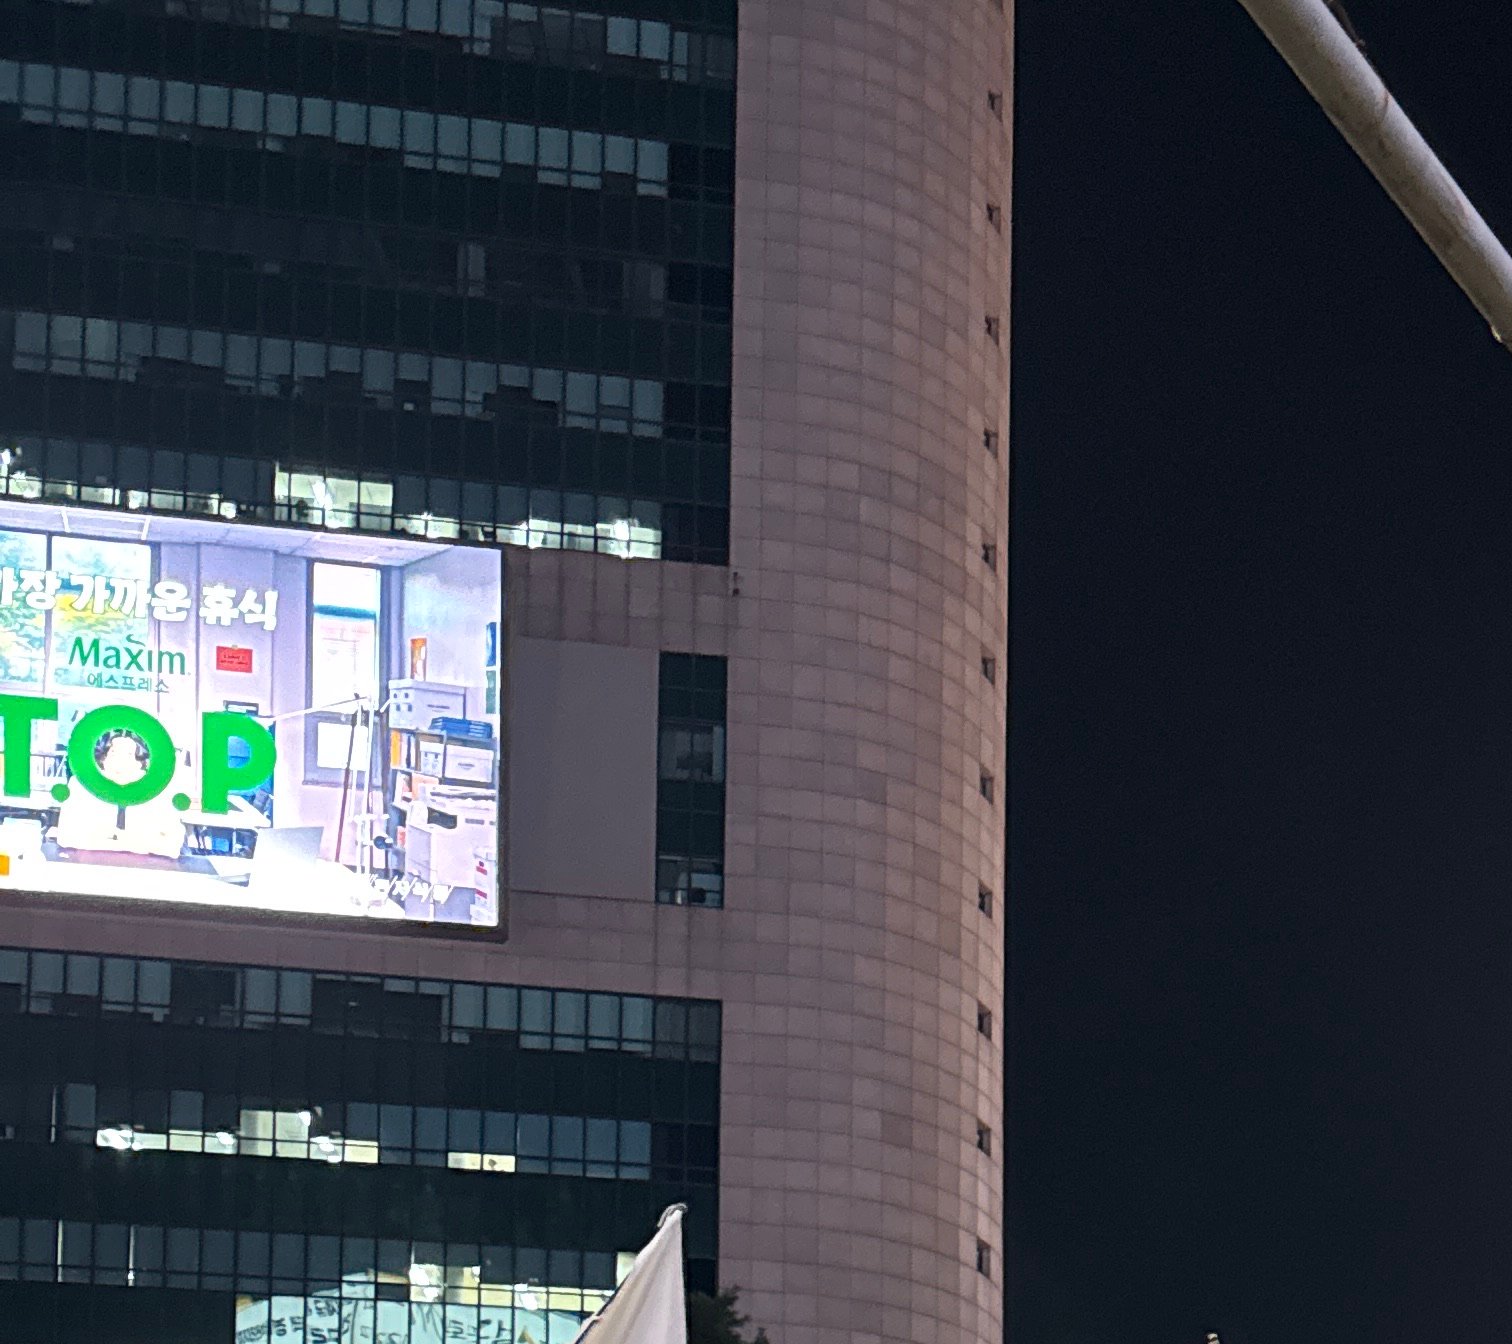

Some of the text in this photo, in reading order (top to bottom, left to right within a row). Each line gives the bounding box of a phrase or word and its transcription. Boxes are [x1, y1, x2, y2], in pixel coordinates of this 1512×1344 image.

[70, 575, 192, 623] 가까운
[199, 584, 279, 631] 휴식
[68, 634, 187, 676] Maxim
[87, 672, 170, 695] 에스프레소
[0, 694, 278, 815] T.O.P
